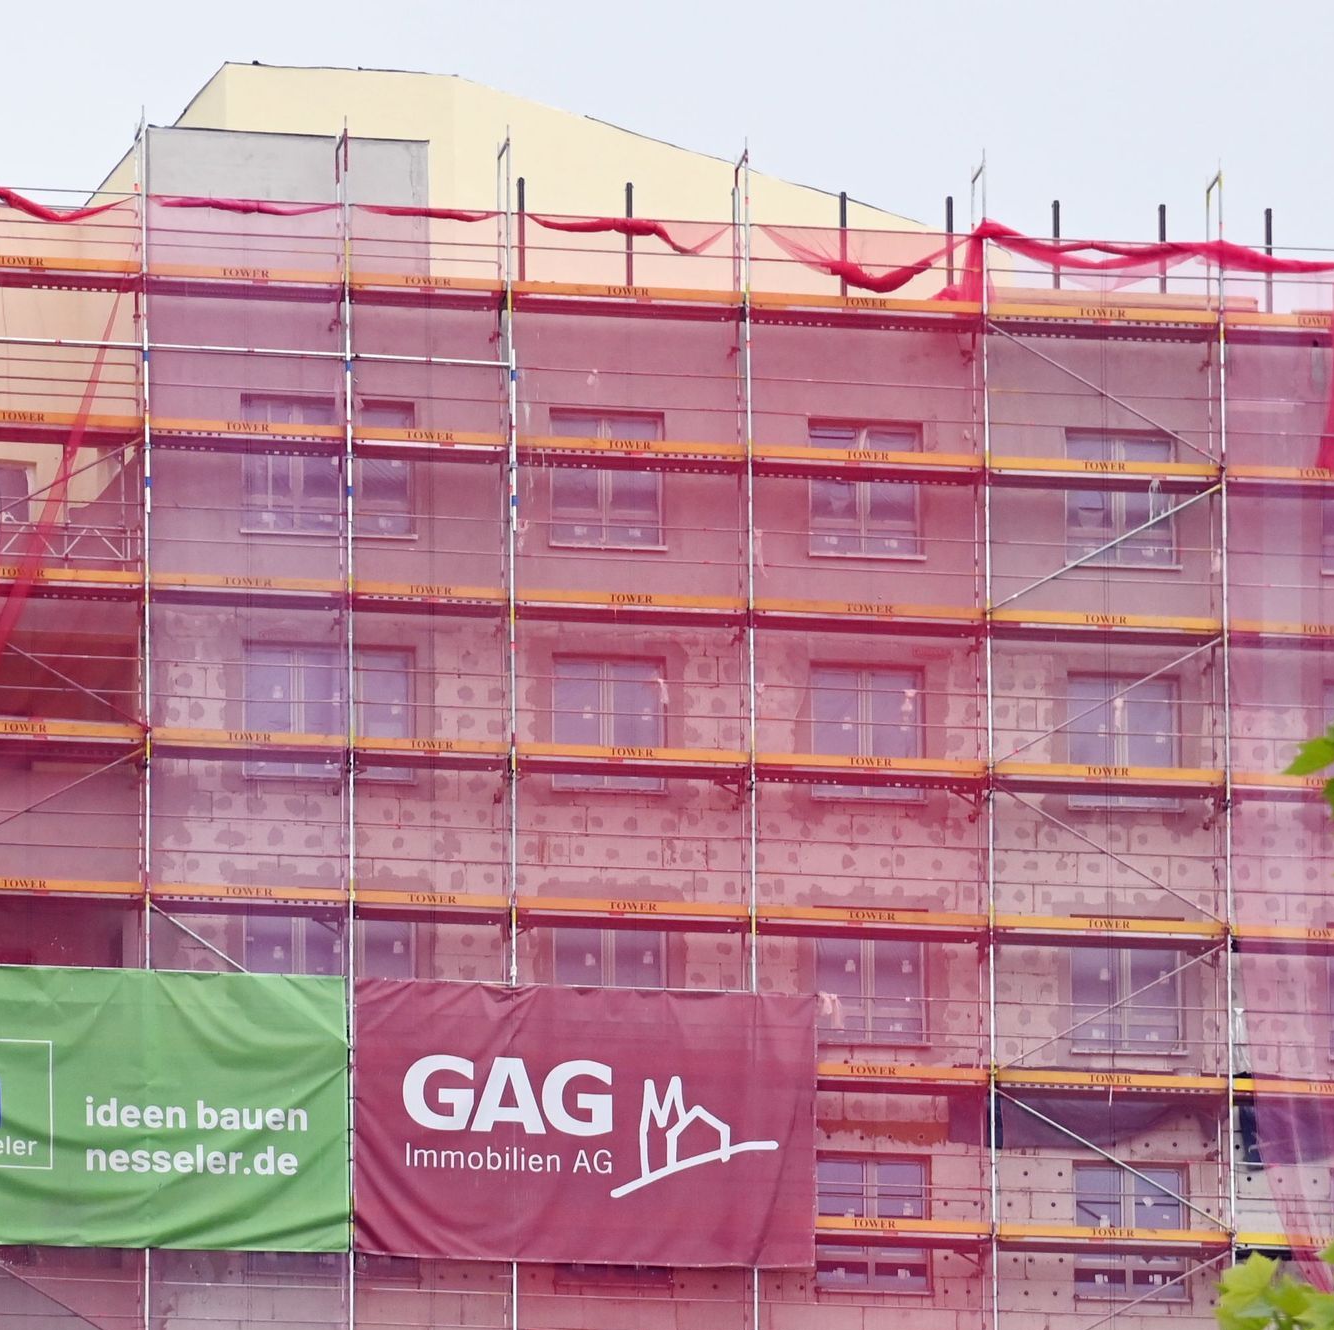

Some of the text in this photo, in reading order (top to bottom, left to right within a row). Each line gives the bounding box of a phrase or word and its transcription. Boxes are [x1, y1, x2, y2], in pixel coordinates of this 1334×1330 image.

[0, 256, 45, 267] TOWER
[220, 268, 269, 279] TOWER
[403, 276, 451, 287] TOWER
[605, 286, 650, 297] TOWER
[844, 297, 887, 308] TOWER
[1078, 308, 1127, 318] TOWER
[1298, 315, 1328, 325] TOWE
[0, 411, 45, 422] TOWER
[226, 422, 270, 432] TOWER
[404, 430, 453, 441] TOWER
[608, 440, 651, 450] TOWER
[846, 450, 889, 461] TOWER
[1083, 461, 1126, 471] TOWER
[1, 568, 45, 578] TOWR
[222, 576, 272, 587] TOWER
[409, 586, 452, 595] TOWER
[610, 594, 653, 604] TOWER
[847, 603, 894, 614] TOWER
[1084, 614, 1127, 624] TOWER
[3, 723, 47, 733] TOWER
[228, 732, 272, 741] TOWER
[410, 740, 454, 749] TOWER
[610, 748, 654, 757] TOWER
[849, 757, 892, 767] TOWER
[1086, 767, 1129, 777] TOWER
[3, 879, 47, 889] TOWER
[223, 887, 272, 897] TOWER
[408, 894, 456, 904] TOWER
[608, 901, 657, 912] TOWER
[847, 911, 896, 921] TOWER
[1087, 919, 1130, 929] TOWER
[847, 1065, 896, 1076] TOWER
[1089, 1074, 1132, 1084] TOWER
[402, 1054, 613, 1137] GAG
[85, 1096, 308, 1132] ideen bauen
[85, 1144, 299, 1176] nesseler.de
[405, 1142, 613, 1175] Immobilien AG
[852, 1219, 896, 1229] TOWER
[1091, 1228, 1134, 1238] TOWER
